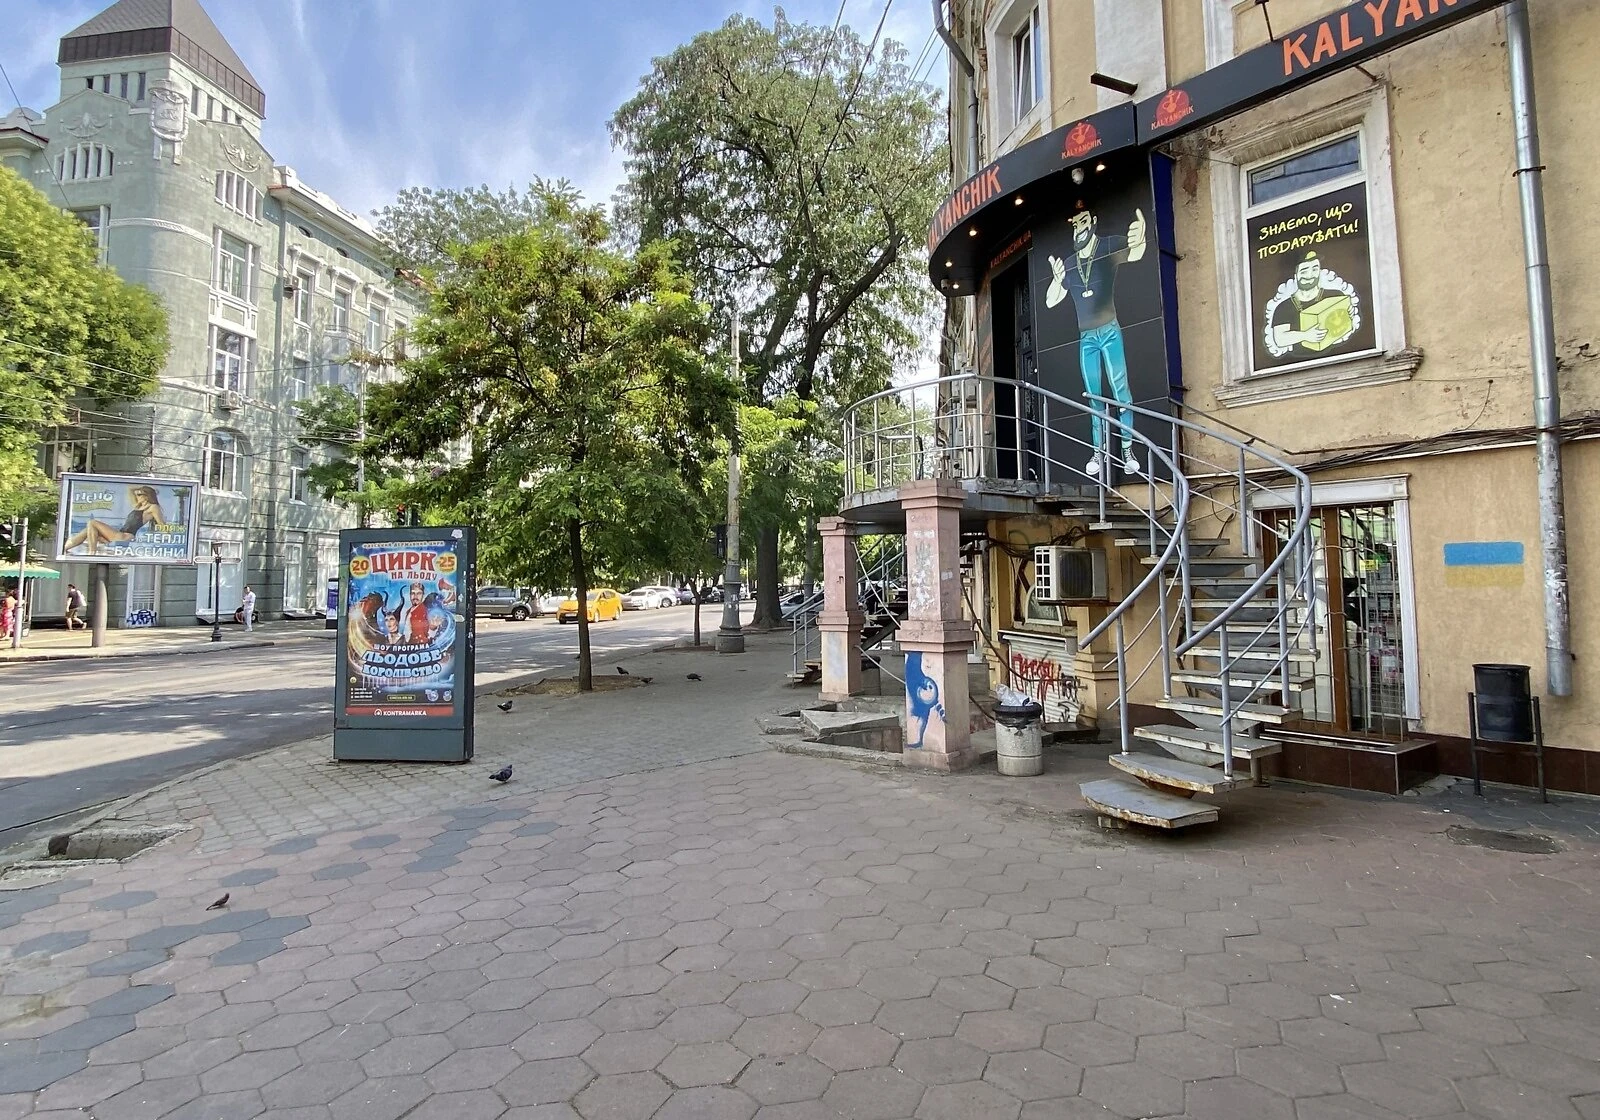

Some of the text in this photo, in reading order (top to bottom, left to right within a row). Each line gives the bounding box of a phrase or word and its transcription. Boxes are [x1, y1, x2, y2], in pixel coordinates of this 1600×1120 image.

[1151, 105, 1194, 130] KALYANCHIK
[1062, 138, 1103, 160] KALYANCHIK
[1259, 202, 1353, 241] ЗНАЄМО, ЩО
[1257, 218, 1359, 260] ПОДАРУВАТИ!
[154, 524, 187, 533] ПЛЯЖ
[145, 533, 186, 544] ТЕПЛІ
[114, 545, 184, 557] БАСЕЙНИ
[370, 551, 437, 573] ЦИРК
[391, 571, 438, 581] НА ЛЬОДУ
[392, 643, 430, 652] ПРОГРАМА
[362, 649, 441, 667] ЛЬОДОВЕ
[362, 663, 442, 678] КОРОЛІВСТВО
